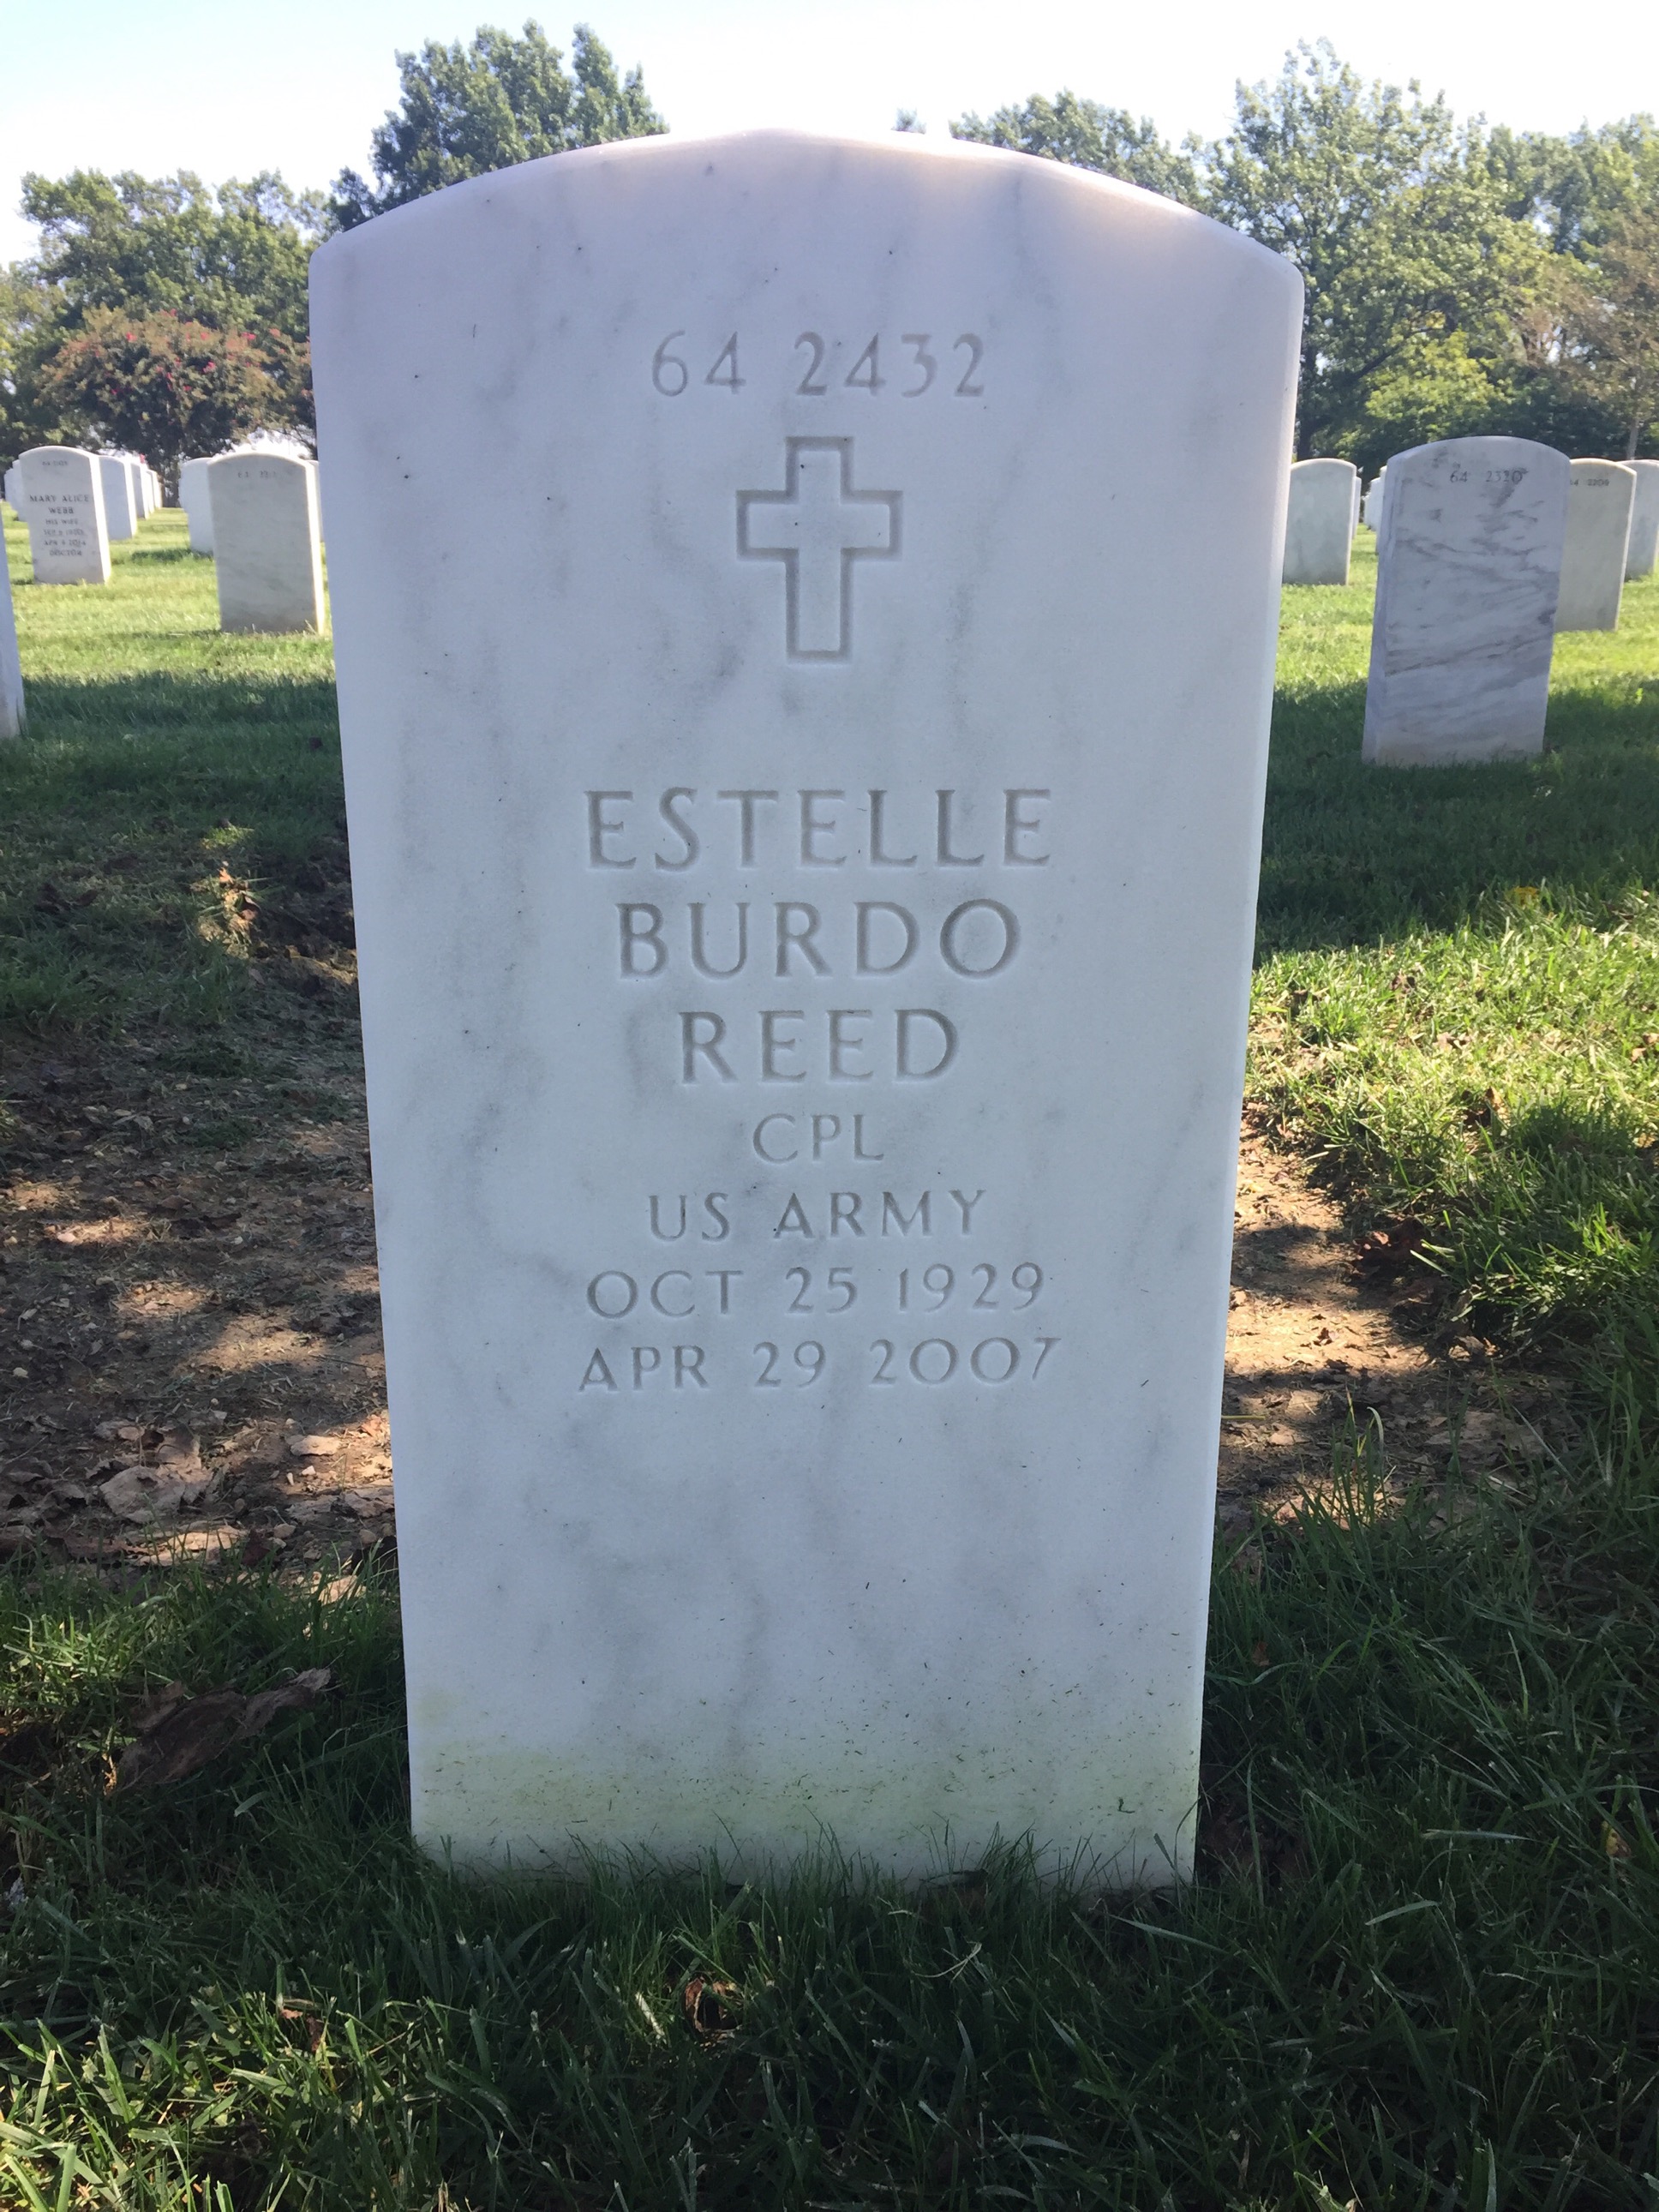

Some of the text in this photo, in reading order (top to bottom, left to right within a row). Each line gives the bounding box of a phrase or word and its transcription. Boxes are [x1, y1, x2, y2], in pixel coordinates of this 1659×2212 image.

[652, 331, 984, 397] 64 2432
[62, 494, 89, 502] ALICE
[1449, 470, 1467, 483] 64
[584, 787, 1051, 871] ESTELLE
[615, 898, 1020, 980] BURDO
[680, 1008, 959, 1083] REED
[752, 1114, 883, 1163] CPL
[649, 1190, 986, 1242] US ARMY
[587, 1262, 1044, 1318] OCT 25 1929
[578, 1336, 1062, 1392] APR 29 2007
